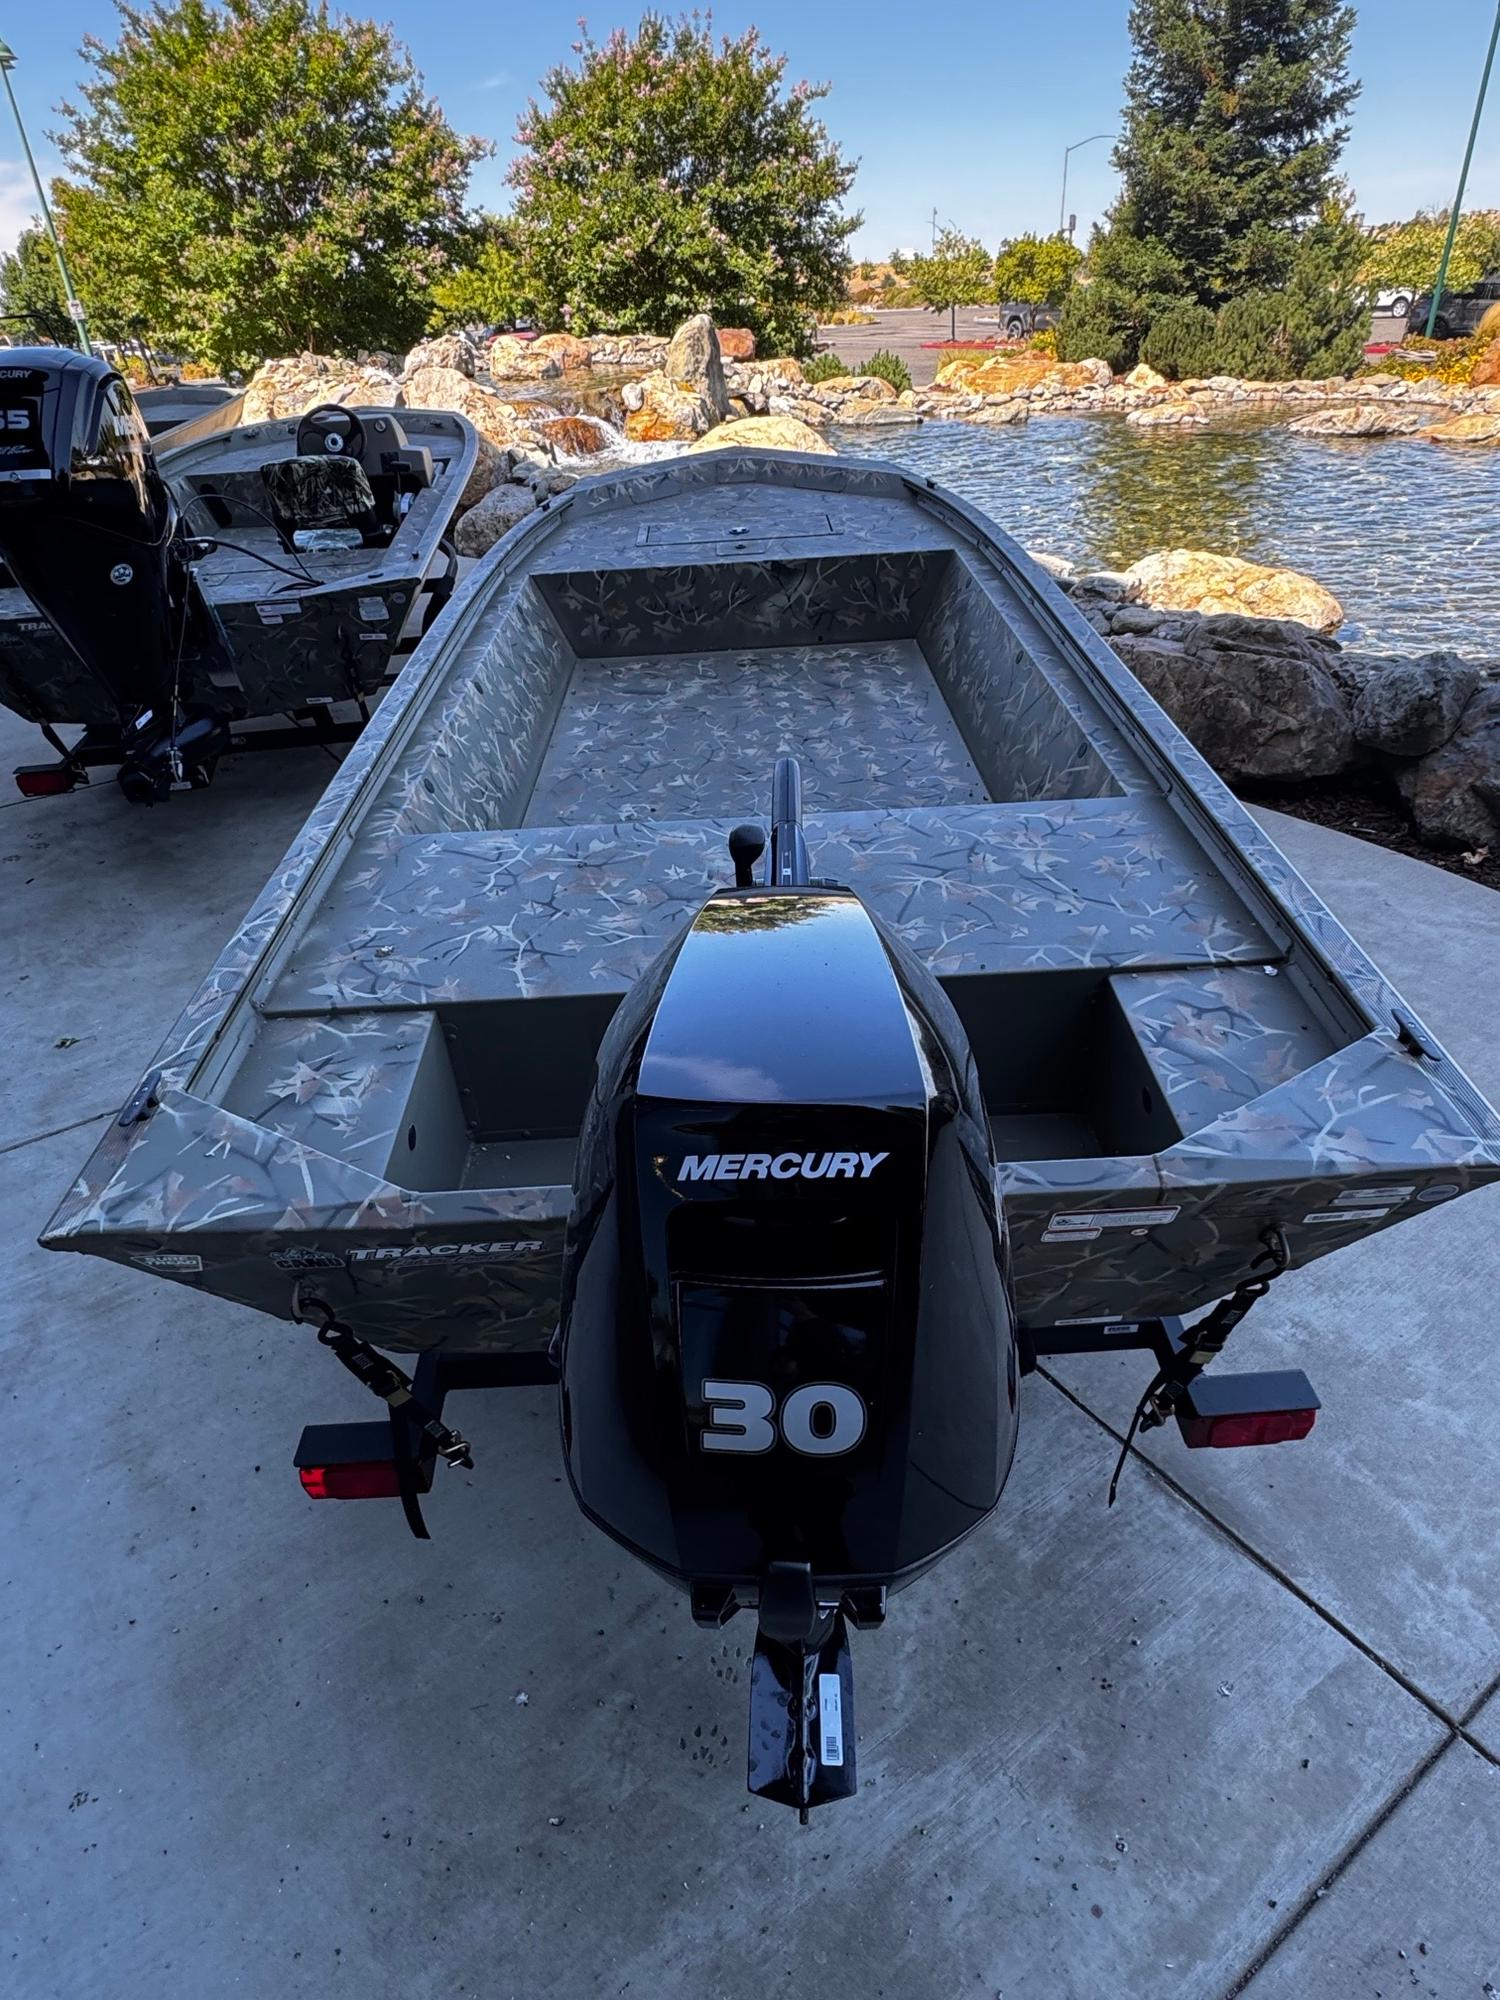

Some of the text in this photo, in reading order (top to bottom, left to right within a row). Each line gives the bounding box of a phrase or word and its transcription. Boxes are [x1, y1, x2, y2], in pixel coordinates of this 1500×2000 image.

[677, 1152, 890, 1181] MERCURY
[349, 1241, 543, 1260] TRACKER
[701, 1379, 867, 1456] 30
